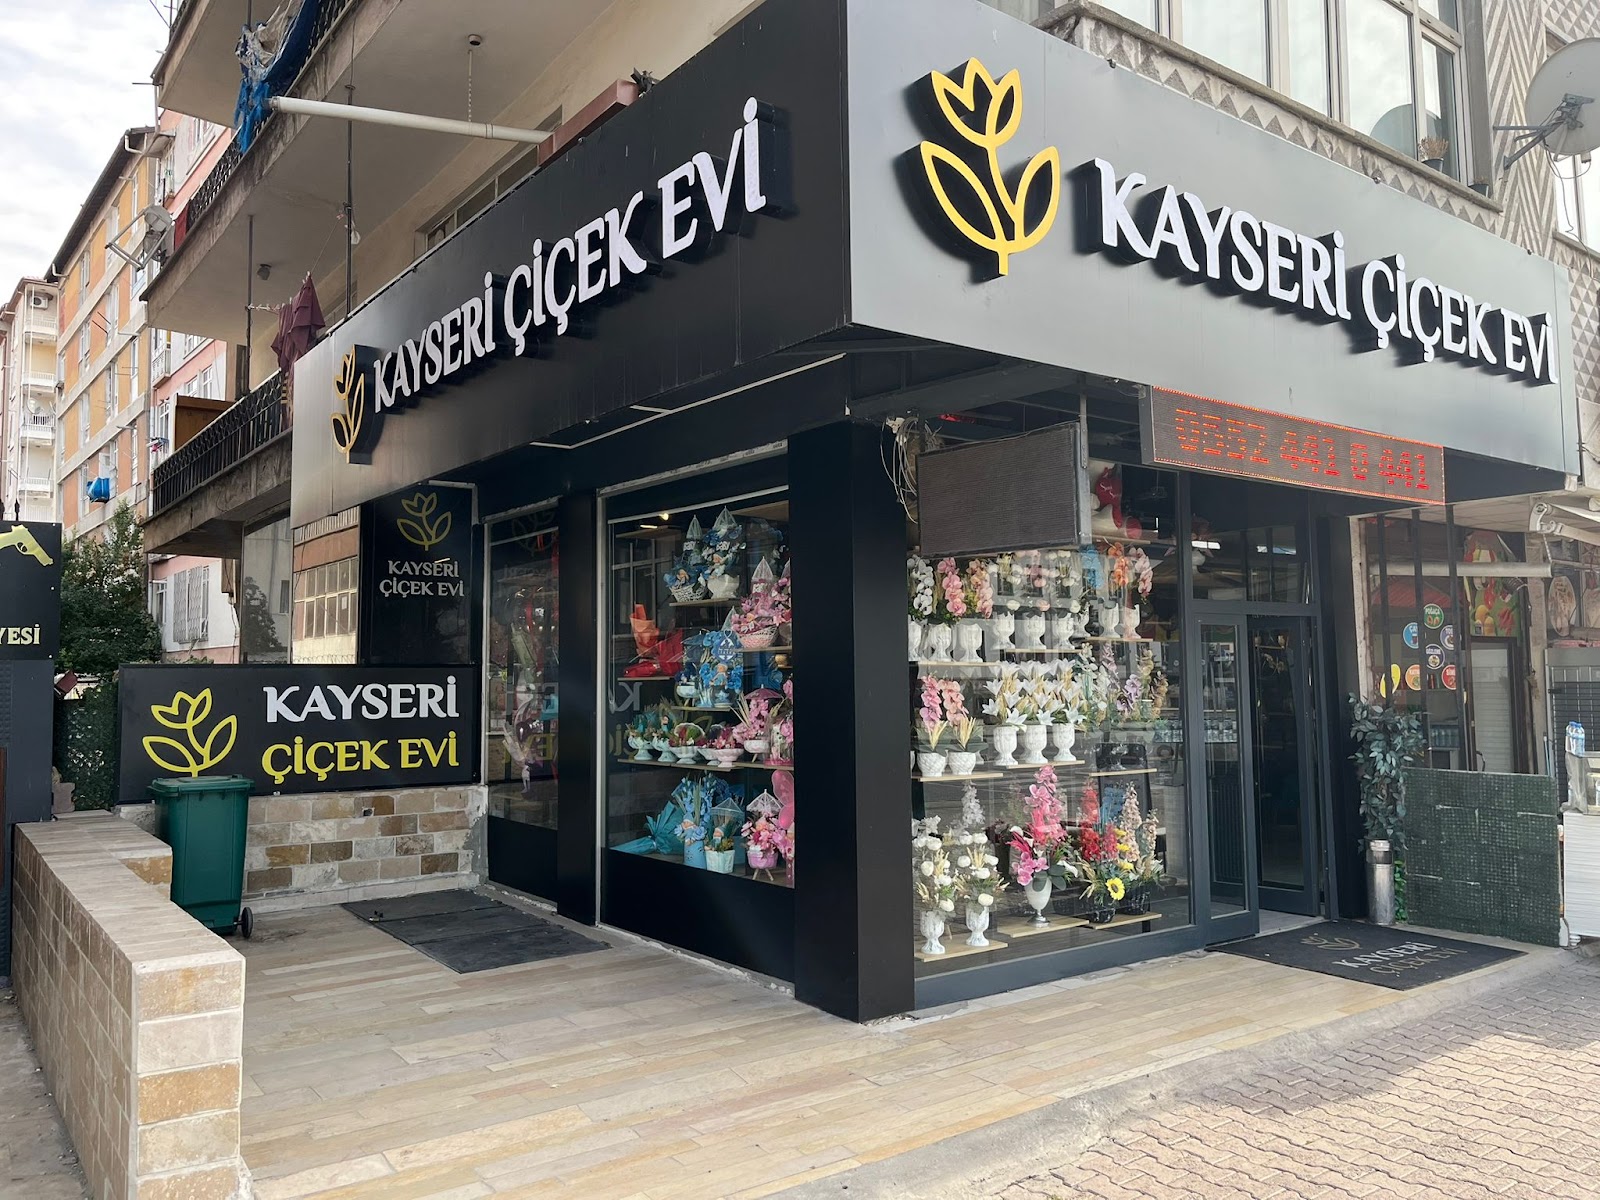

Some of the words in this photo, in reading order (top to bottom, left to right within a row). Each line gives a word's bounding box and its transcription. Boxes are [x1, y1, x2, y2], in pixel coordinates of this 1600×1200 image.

[374, 271, 496, 413] KAYSERİ
[504, 190, 647, 357] ÇİÇEK
[657, 96, 766, 259] EVİ
[1094, 157, 1352, 321] KAYSERİ
[1361, 252, 1498, 363] ÇİÇEK
[1499, 307, 1559, 385] EVİ
[1279, 430, 1340, 477] 441
[1378, 448, 1430, 490] 441
[379, 577, 434, 598] ÇİÇEK
[437, 580, 465, 597] EVİ
[388, 560, 460, 578] KAYSERİ
[262, 675, 460, 723] KAYSERİ
[261, 735, 391, 785] ÇİÇEK
[398, 730, 460, 769] EVİ
[1332, 941, 1437, 968] KAYSERİ
